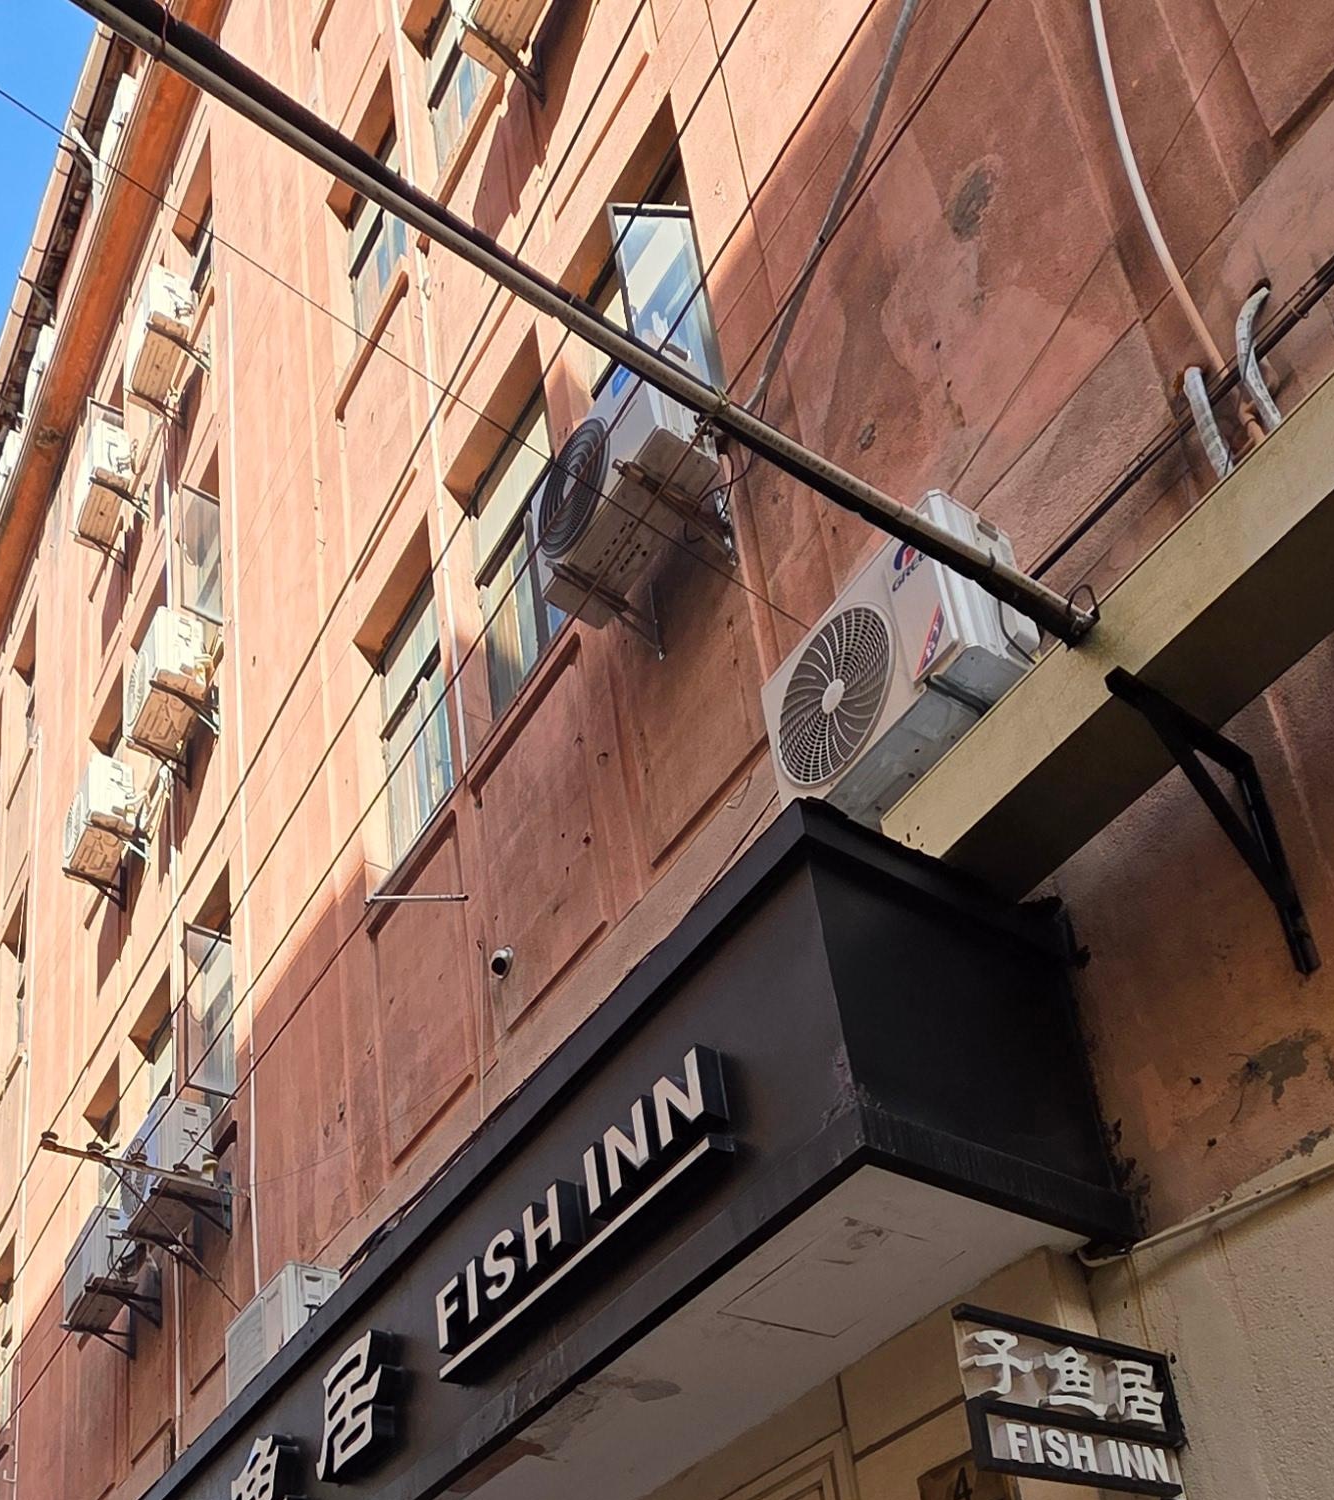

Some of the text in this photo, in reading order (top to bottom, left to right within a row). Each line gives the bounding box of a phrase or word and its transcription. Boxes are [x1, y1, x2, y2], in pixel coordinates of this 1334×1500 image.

[435, 1044, 711, 1352] FISH INN
[971, 1329, 1164, 1426] 子鱼居
[1005, 1422, 1171, 1483] FISH INN
